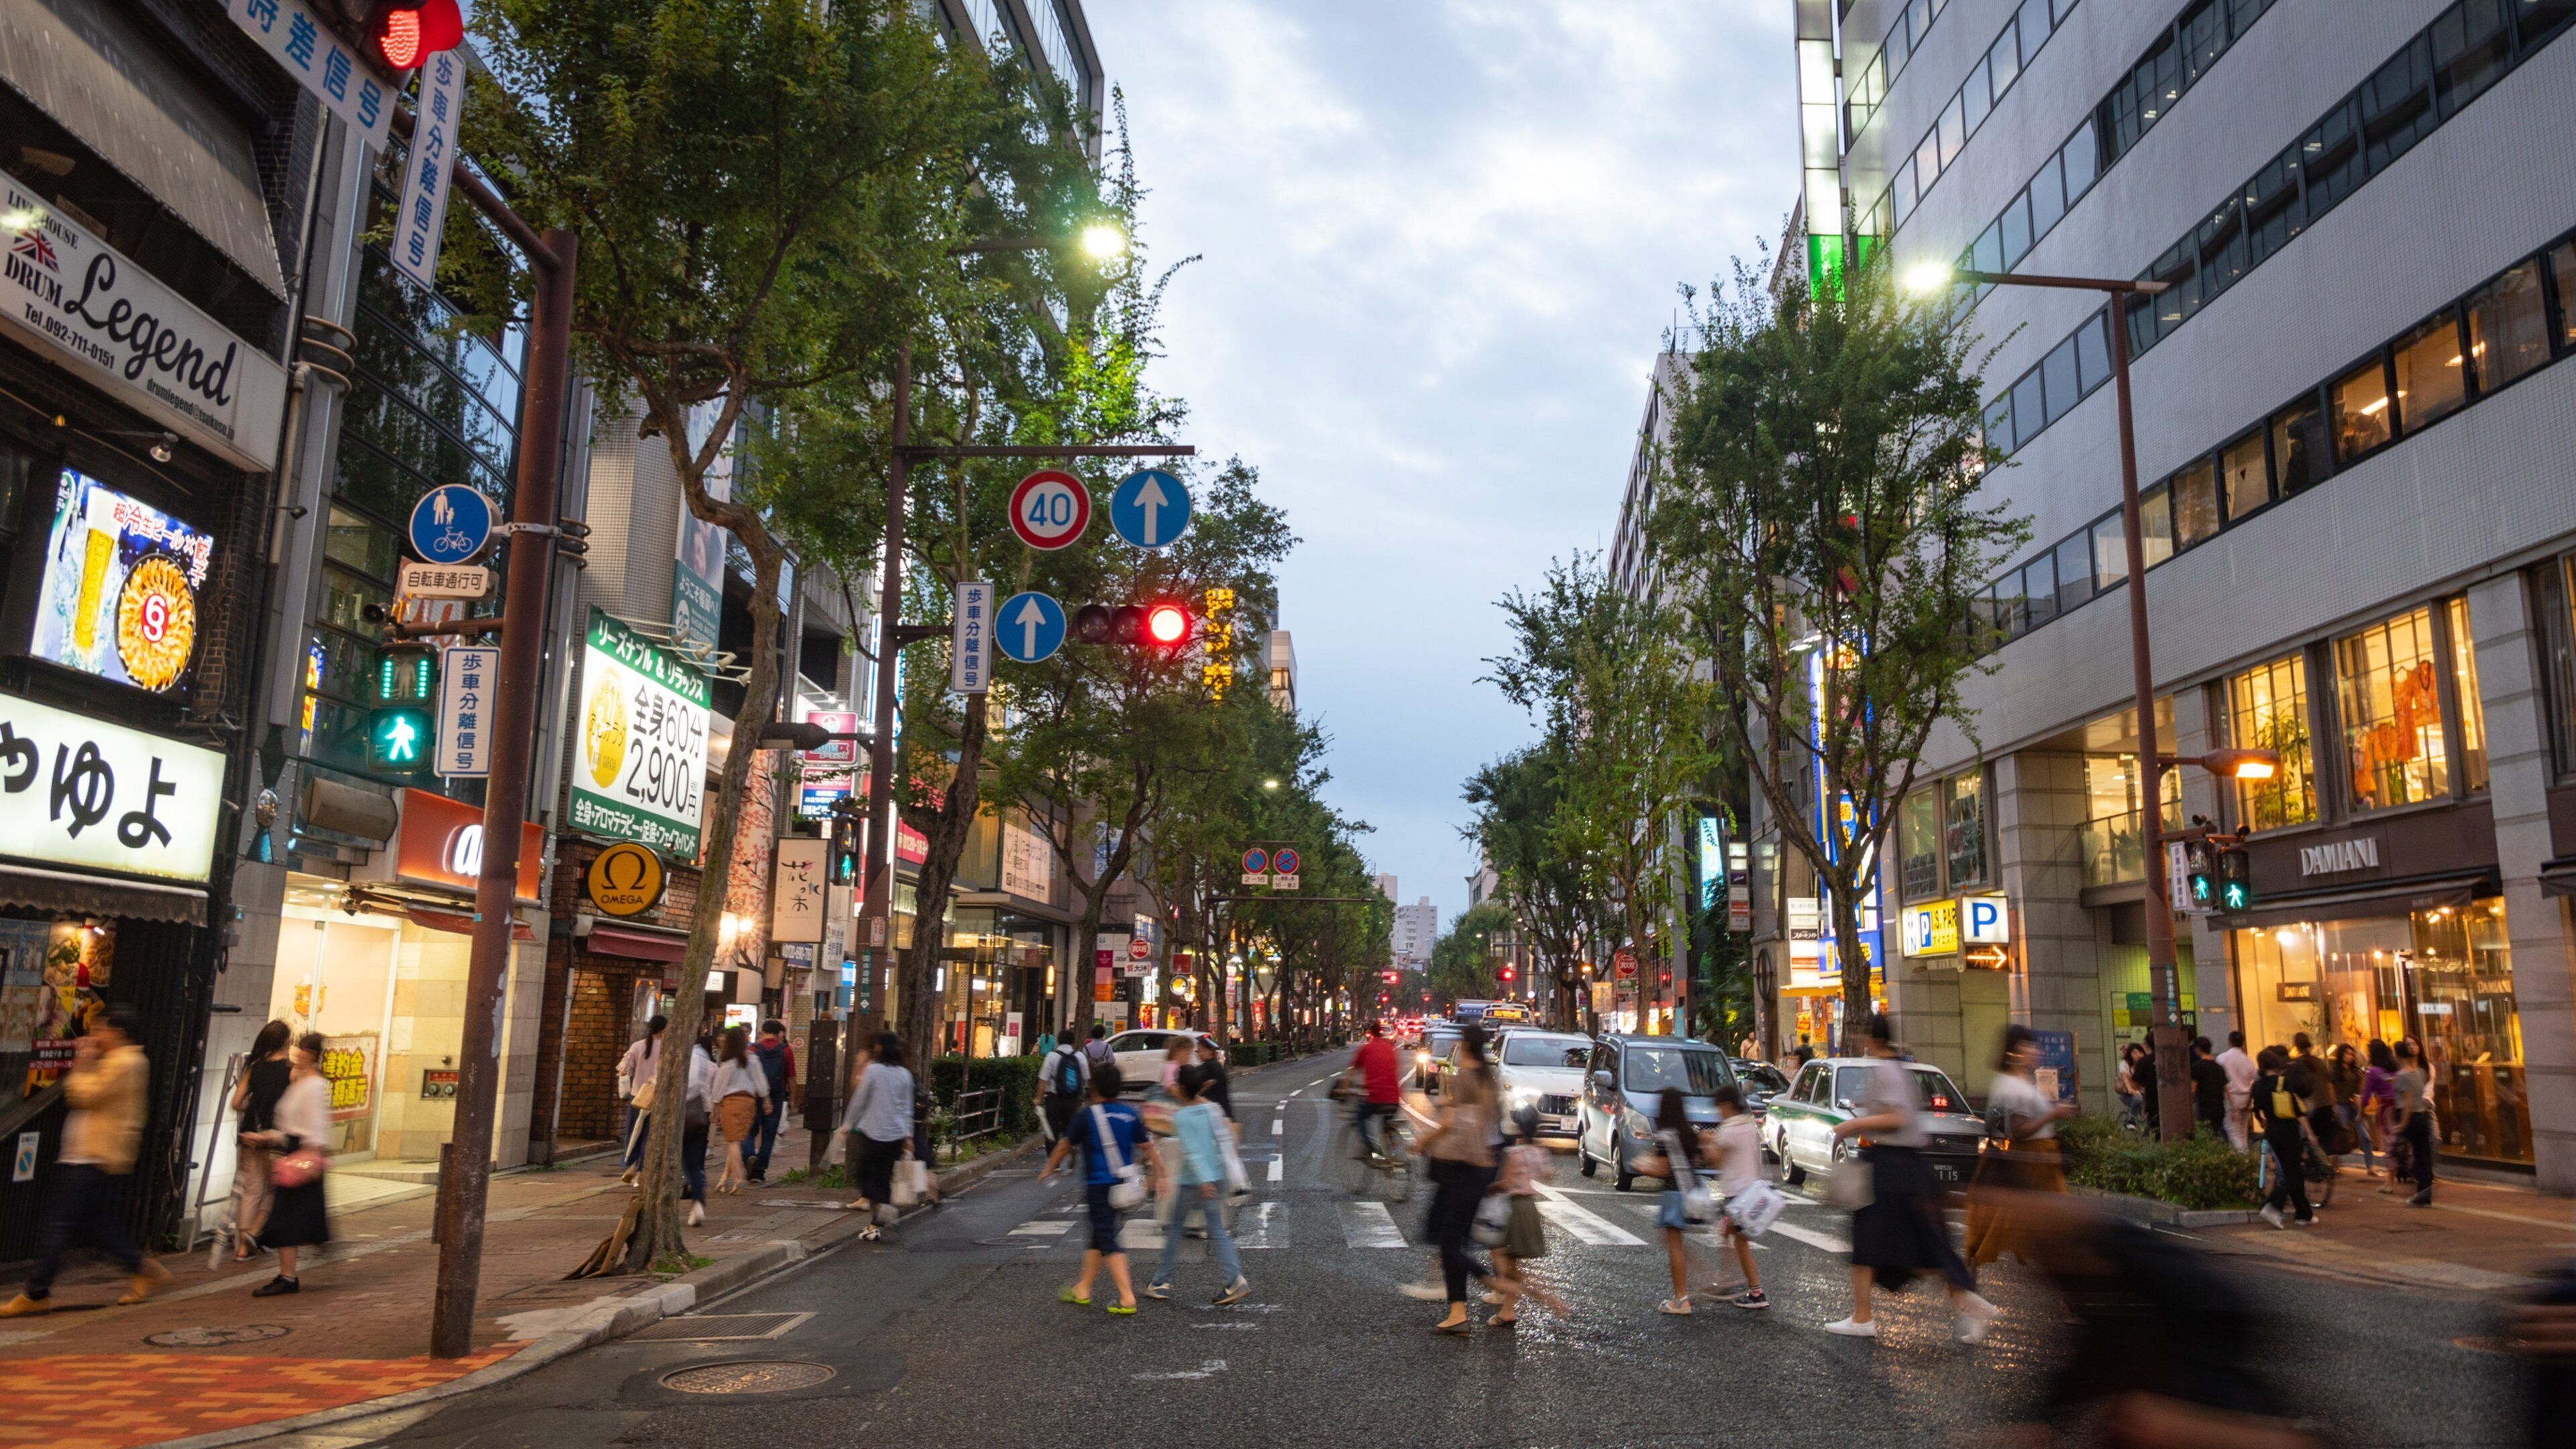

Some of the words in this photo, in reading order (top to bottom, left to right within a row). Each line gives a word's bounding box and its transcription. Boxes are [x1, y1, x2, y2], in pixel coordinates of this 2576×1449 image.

[408, 53, 453, 268] 歩車分離信号
[4, 252, 64, 309] DRUM
[63, 252, 237, 407] Legend
[1028, 492, 1071, 527] 40
[407, 570, 484, 591] 自転車通行可
[598, 620, 652, 671] リーズナブル
[655, 661, 665, 680] &
[668, 662, 704, 701] リラックス
[963, 588, 982, 688] 歩車分離信号
[454, 653, 483, 769] 歩車分離信号
[633, 683, 703, 759] 全身60分
[2300, 837, 2379, 877] DAMIANI
[600, 894, 644, 904] OMEGA
[1972, 902, 1997, 937] P
